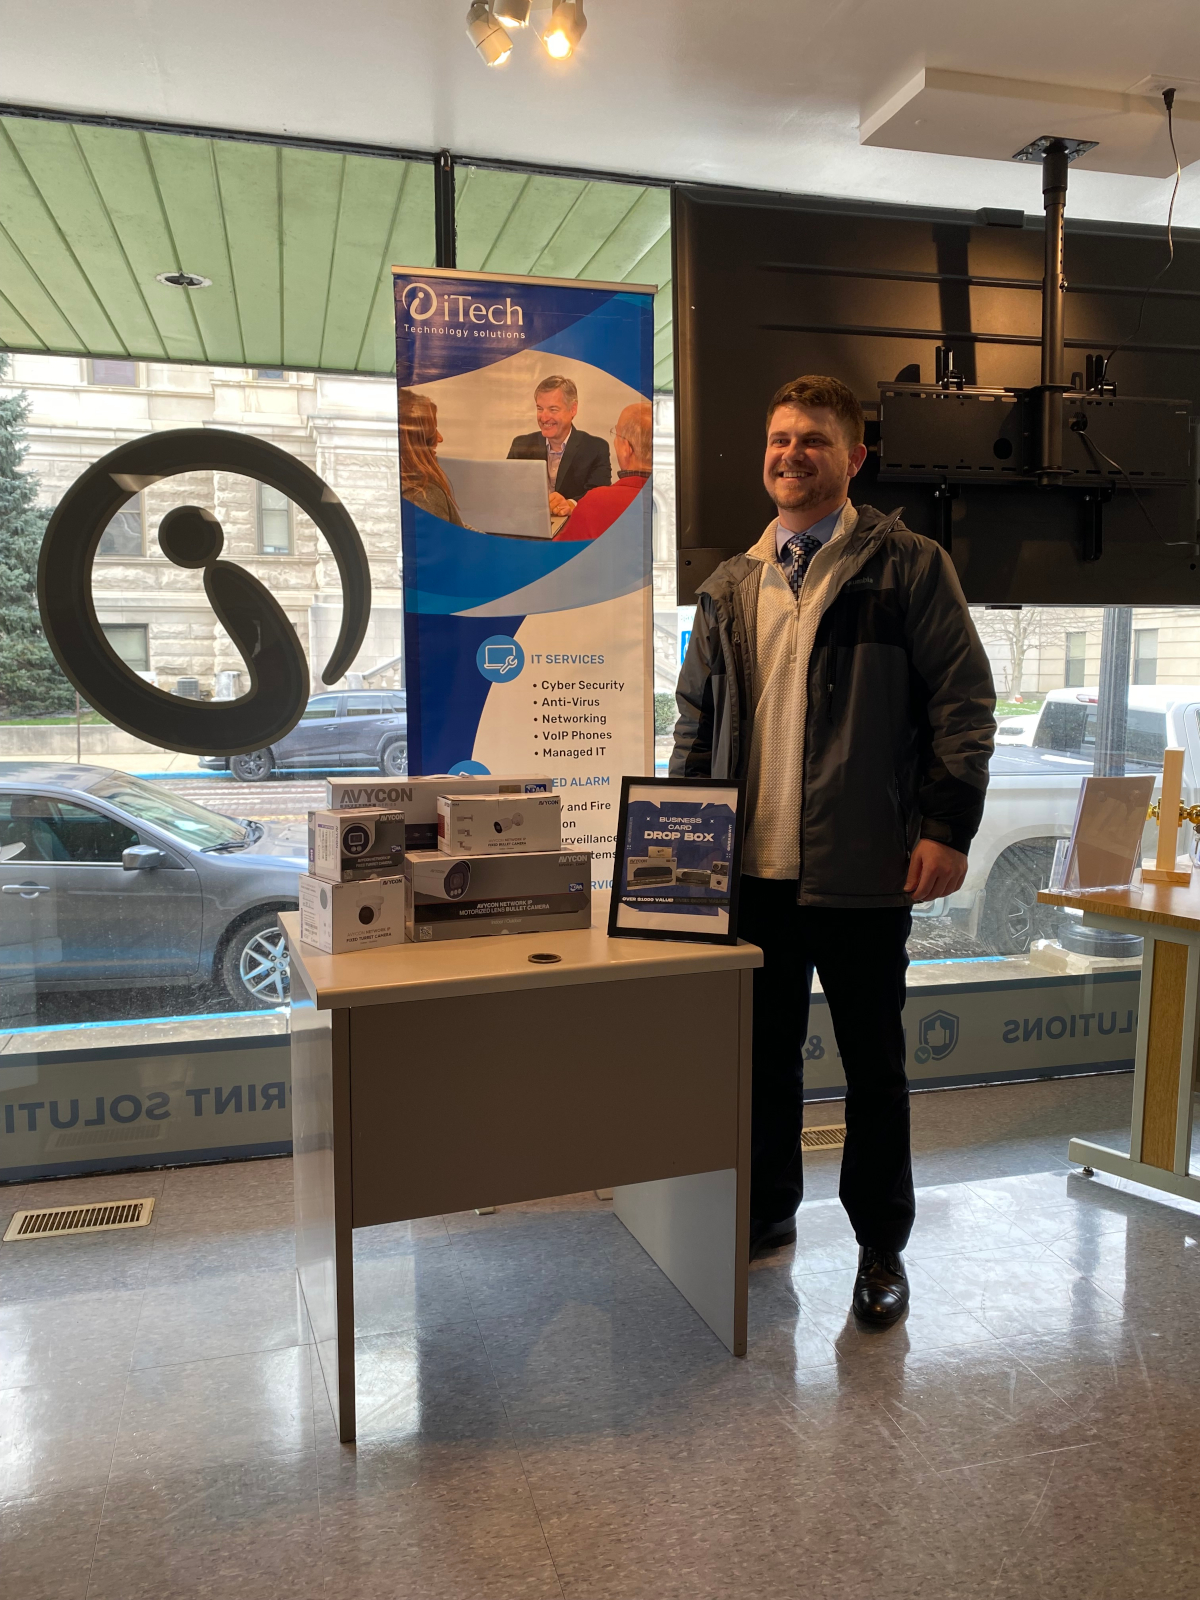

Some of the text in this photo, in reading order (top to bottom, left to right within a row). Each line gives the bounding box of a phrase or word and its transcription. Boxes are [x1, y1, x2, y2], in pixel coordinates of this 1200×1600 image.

[444, 294, 524, 326] iTech
[404, 324, 526, 339] Technology solutions
[531, 654, 605, 664] IT SERVICES
[541, 680, 625, 691] Cyber Security
[542, 697, 600, 707] Anti-Virus
[542, 714, 607, 724] Networking
[542, 730, 612, 741] VoIP Phones
[543, 747, 606, 758] Managed IT
[570, 776, 610, 787] ALARM
[340, 788, 412, 803] AVYCON
[567, 802, 587, 812] and
[590, 801, 611, 810] Fire
[644, 831, 714, 842] DROP BOX
